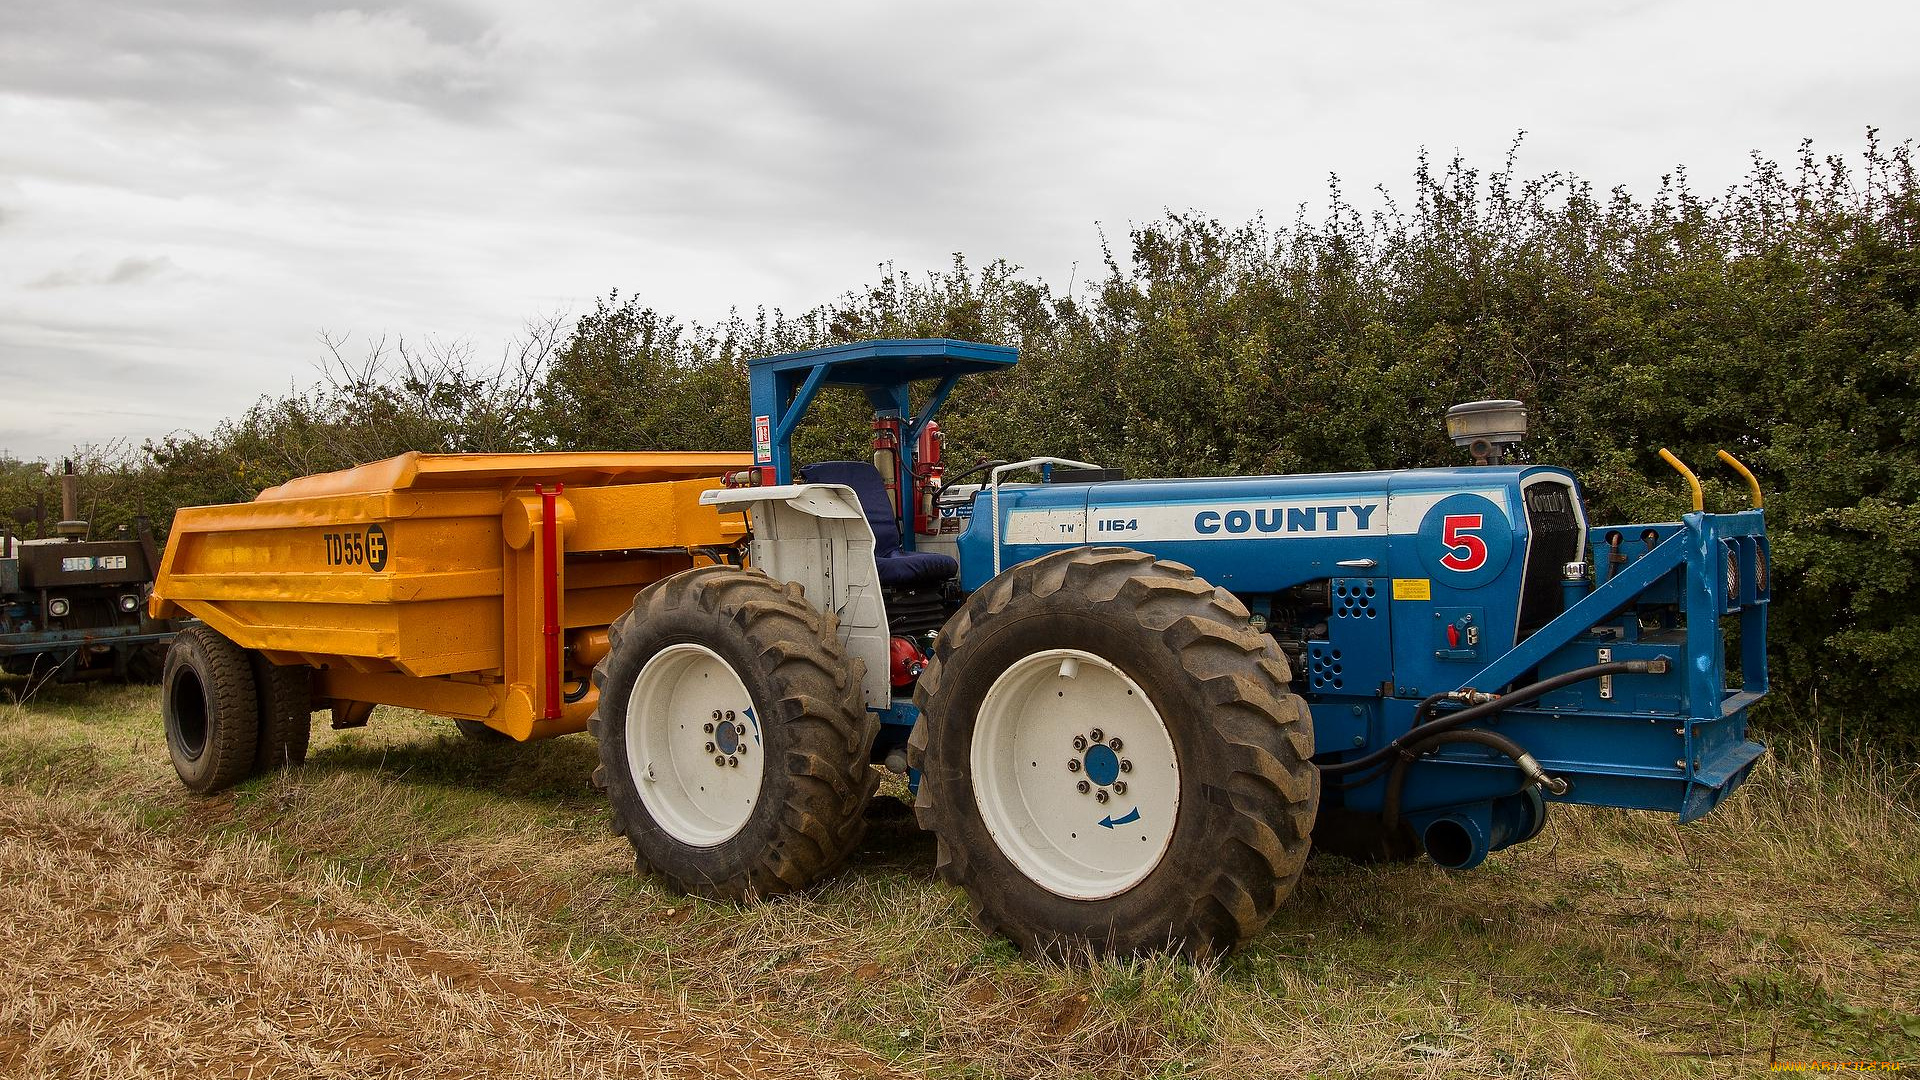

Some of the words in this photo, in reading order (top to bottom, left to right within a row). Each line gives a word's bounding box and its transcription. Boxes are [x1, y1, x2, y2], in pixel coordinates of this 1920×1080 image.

[1059, 523, 1075, 533] TW
[1098, 519, 1138, 532] 1164
[1194, 504, 1378, 535] COUNTY
[323, 532, 364, 566] TD55
[1440, 514, 1487, 572] 5
